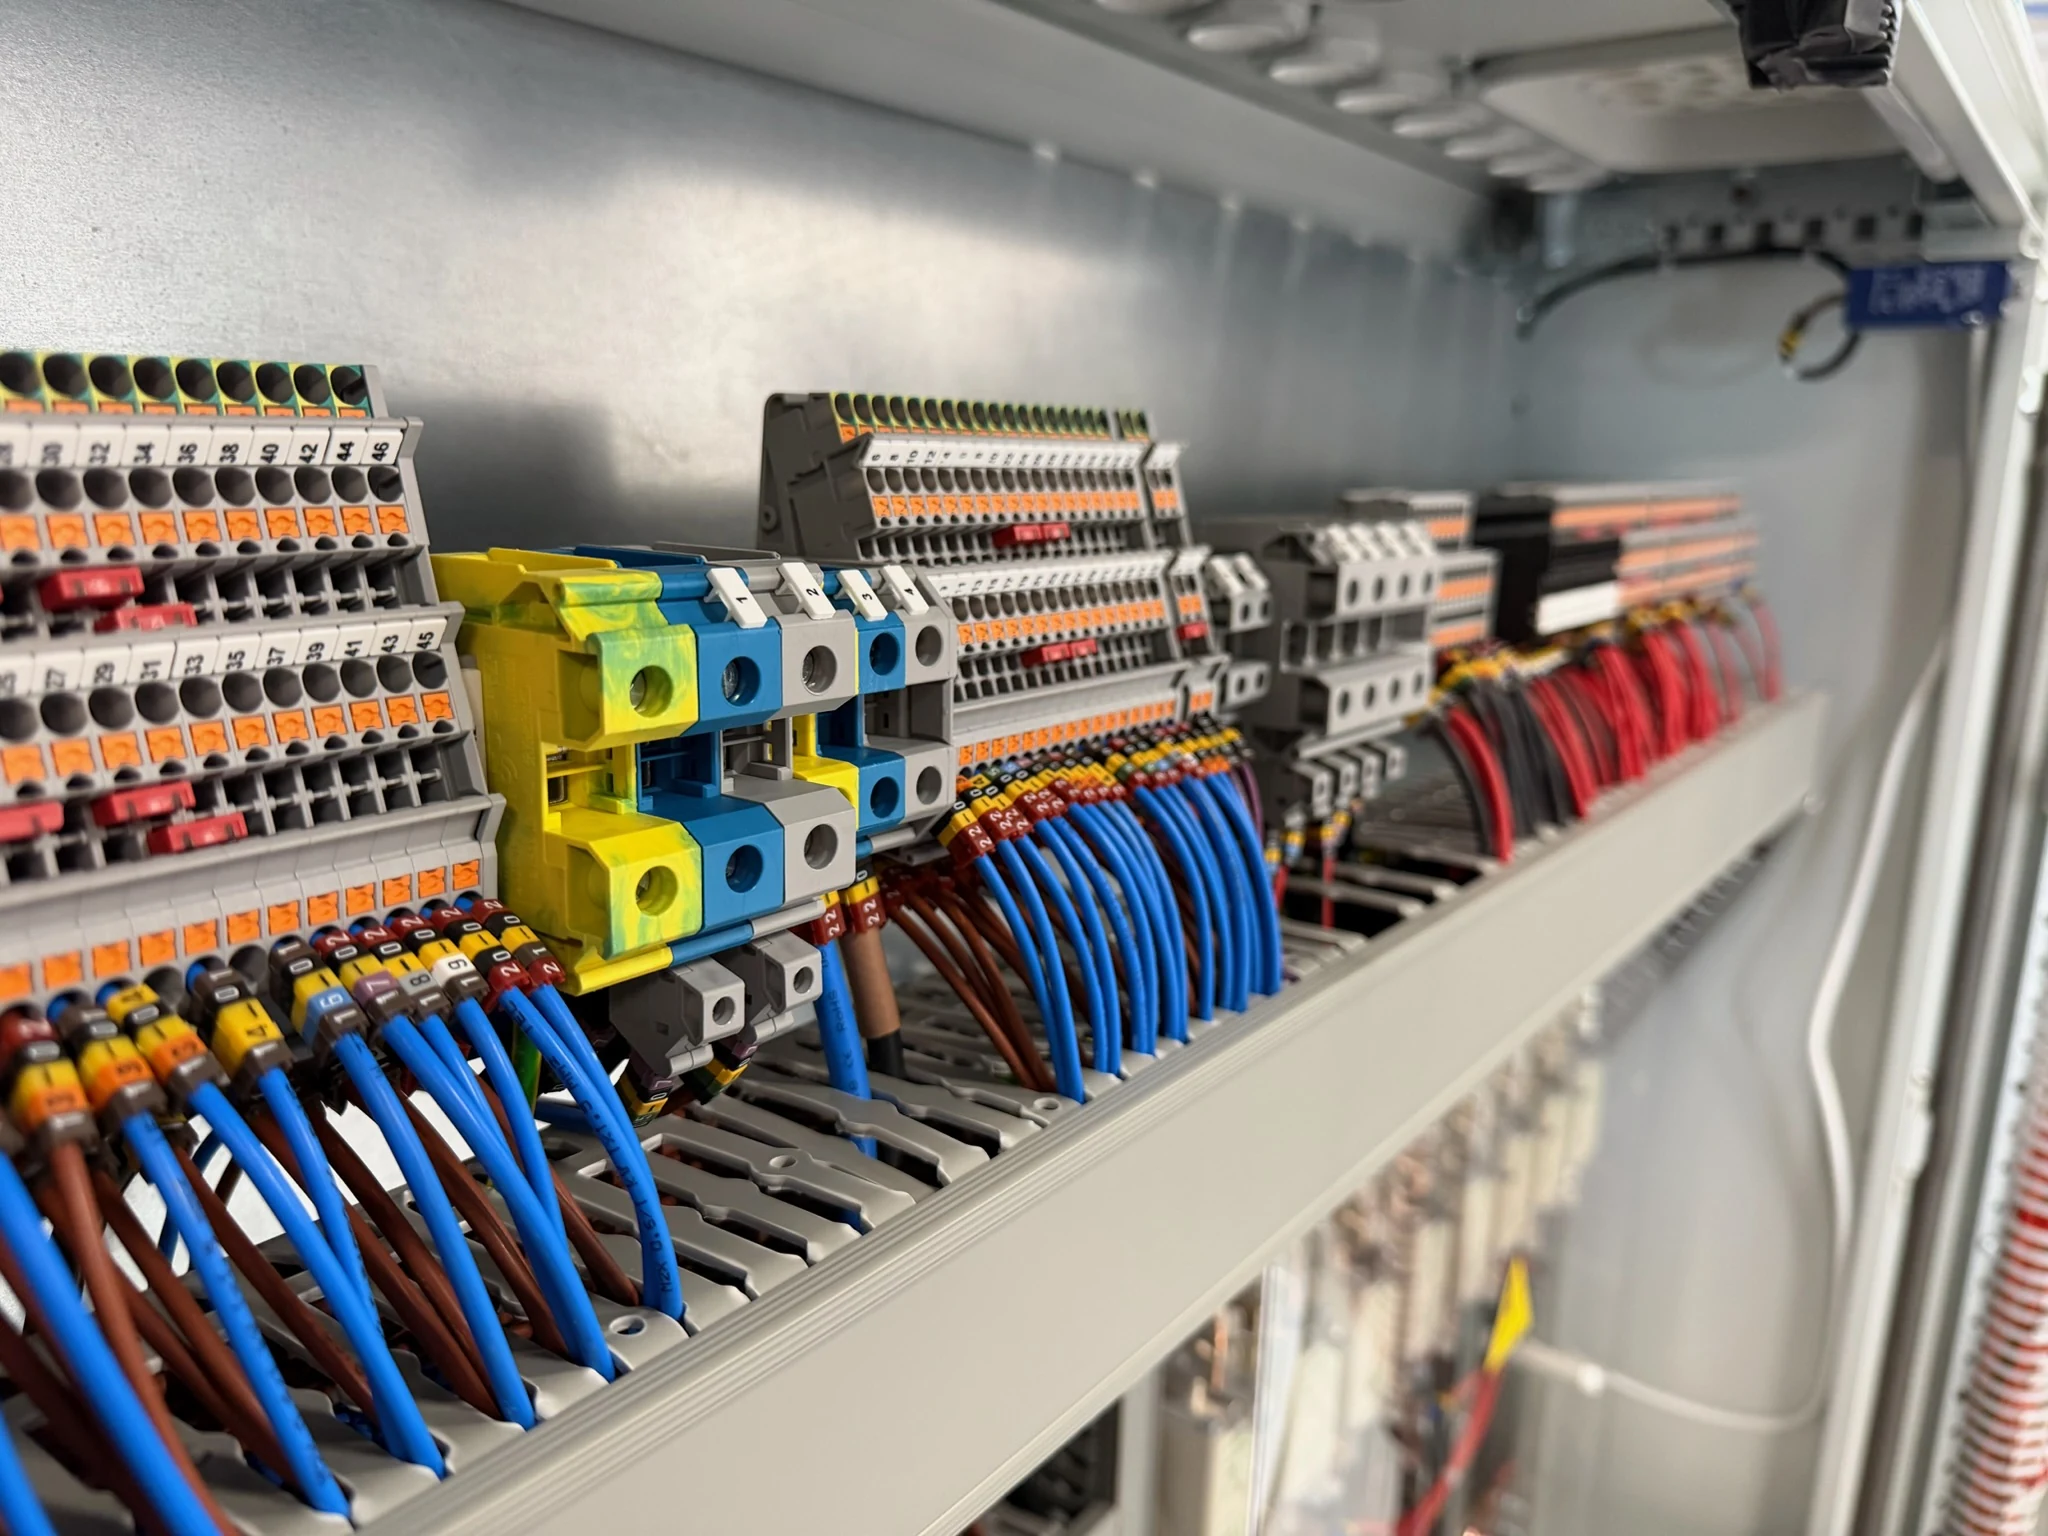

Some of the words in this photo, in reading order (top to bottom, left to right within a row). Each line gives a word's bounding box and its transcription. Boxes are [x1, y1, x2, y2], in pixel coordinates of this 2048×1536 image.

[89, 442, 111, 464] 32
[133, 441, 155, 464] 34
[177, 442, 199, 464] 36
[219, 442, 240, 464] 38
[260, 443, 280, 464] 40
[299, 443, 319, 464] 42
[336, 441, 355, 462] 44
[371, 441, 390, 462] 46
[736, 596, 748, 604] 1
[806, 588, 819, 597] 2
[862, 593, 873, 601] 3
[904, 587, 915, 596] 4
[306, 641, 325, 661] 39
[344, 639, 363, 657] 41
[381, 634, 399, 653] 43
[416, 631, 434, 650] 45
[184, 654, 204, 675] 33
[225, 649, 246, 671] 35
[267, 647, 286, 666] 37
[140, 659, 162, 680] 31
[953, 800, 993, 849] 22-0
[855, 868, 881, 927] 22-0
